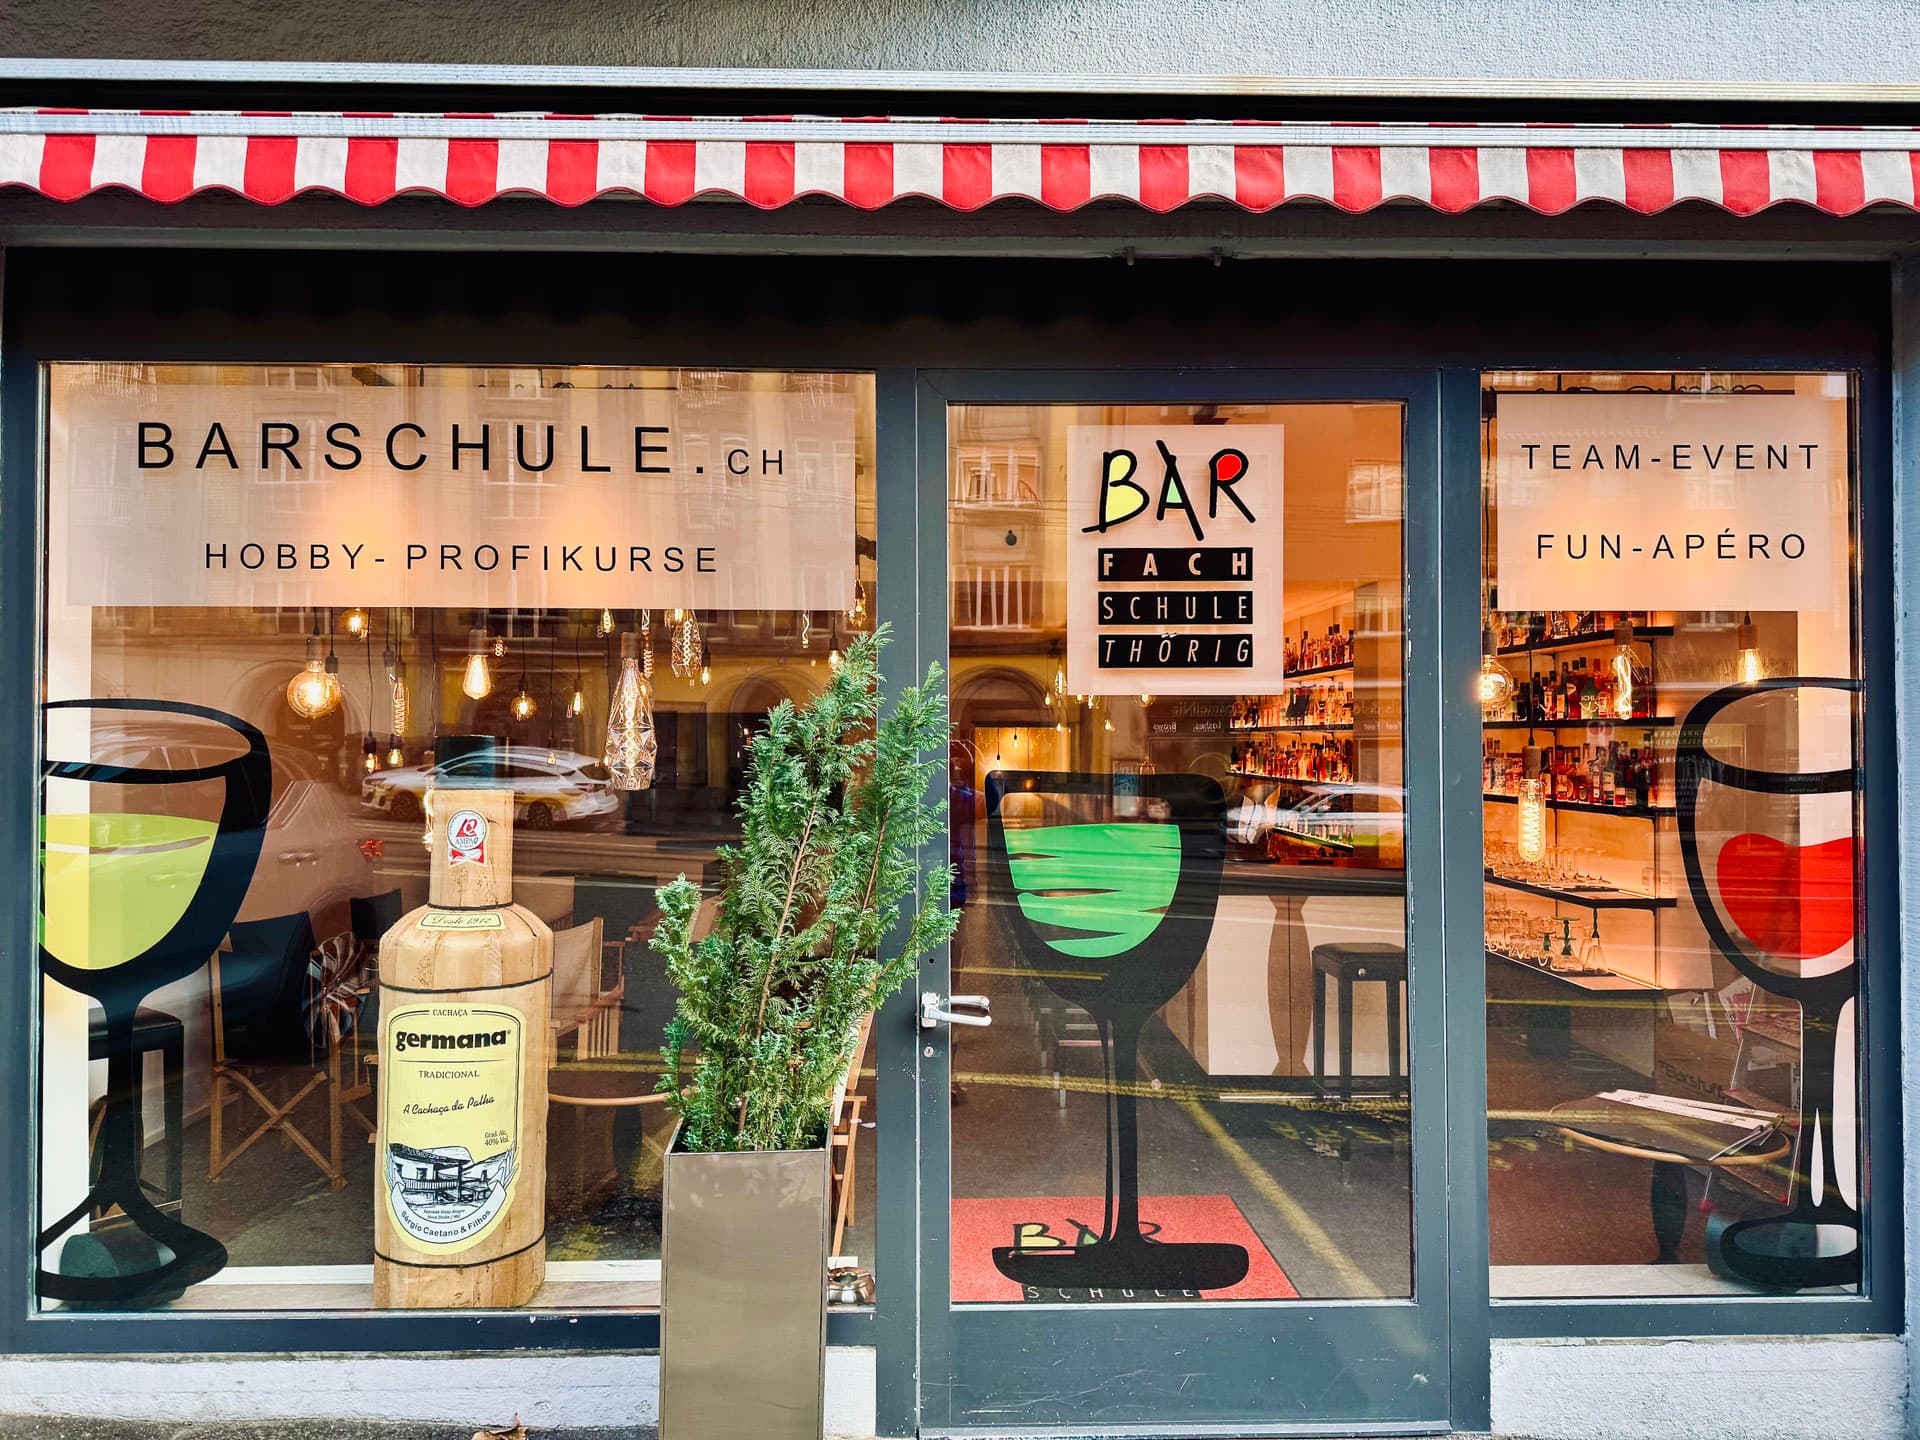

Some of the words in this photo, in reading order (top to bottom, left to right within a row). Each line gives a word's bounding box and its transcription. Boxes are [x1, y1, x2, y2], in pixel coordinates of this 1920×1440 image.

[1521, 444, 1819, 470] TEAM-EVENT
[1537, 527, 1805, 560] FUN-APÉRO
[205, 543, 385, 570] HOBBY-
[407, 544, 717, 573] PROFIKURSE
[1103, 552, 1247, 576] FACH
[1103, 596, 1247, 620] SCHULE
[1104, 632, 1250, 663] THÖRIG
[431, 915, 463, 925] Desde
[432, 1009, 469, 1018] CACHAÇA
[395, 1030, 507, 1052] germana
[418, 1070, 481, 1079] TRADICIONAL
[402, 1104, 410, 1115] A
[411, 1103, 450, 1116] Cachaça
[451, 1099, 465, 1111] da
[466, 1094, 495, 1109] Palha
[401, 1210, 422, 1231] Sérgio
[423, 1226, 459, 1238] Caetano
[460, 1226, 467, 1234] &
[467, 1210, 491, 1231] Filhos
